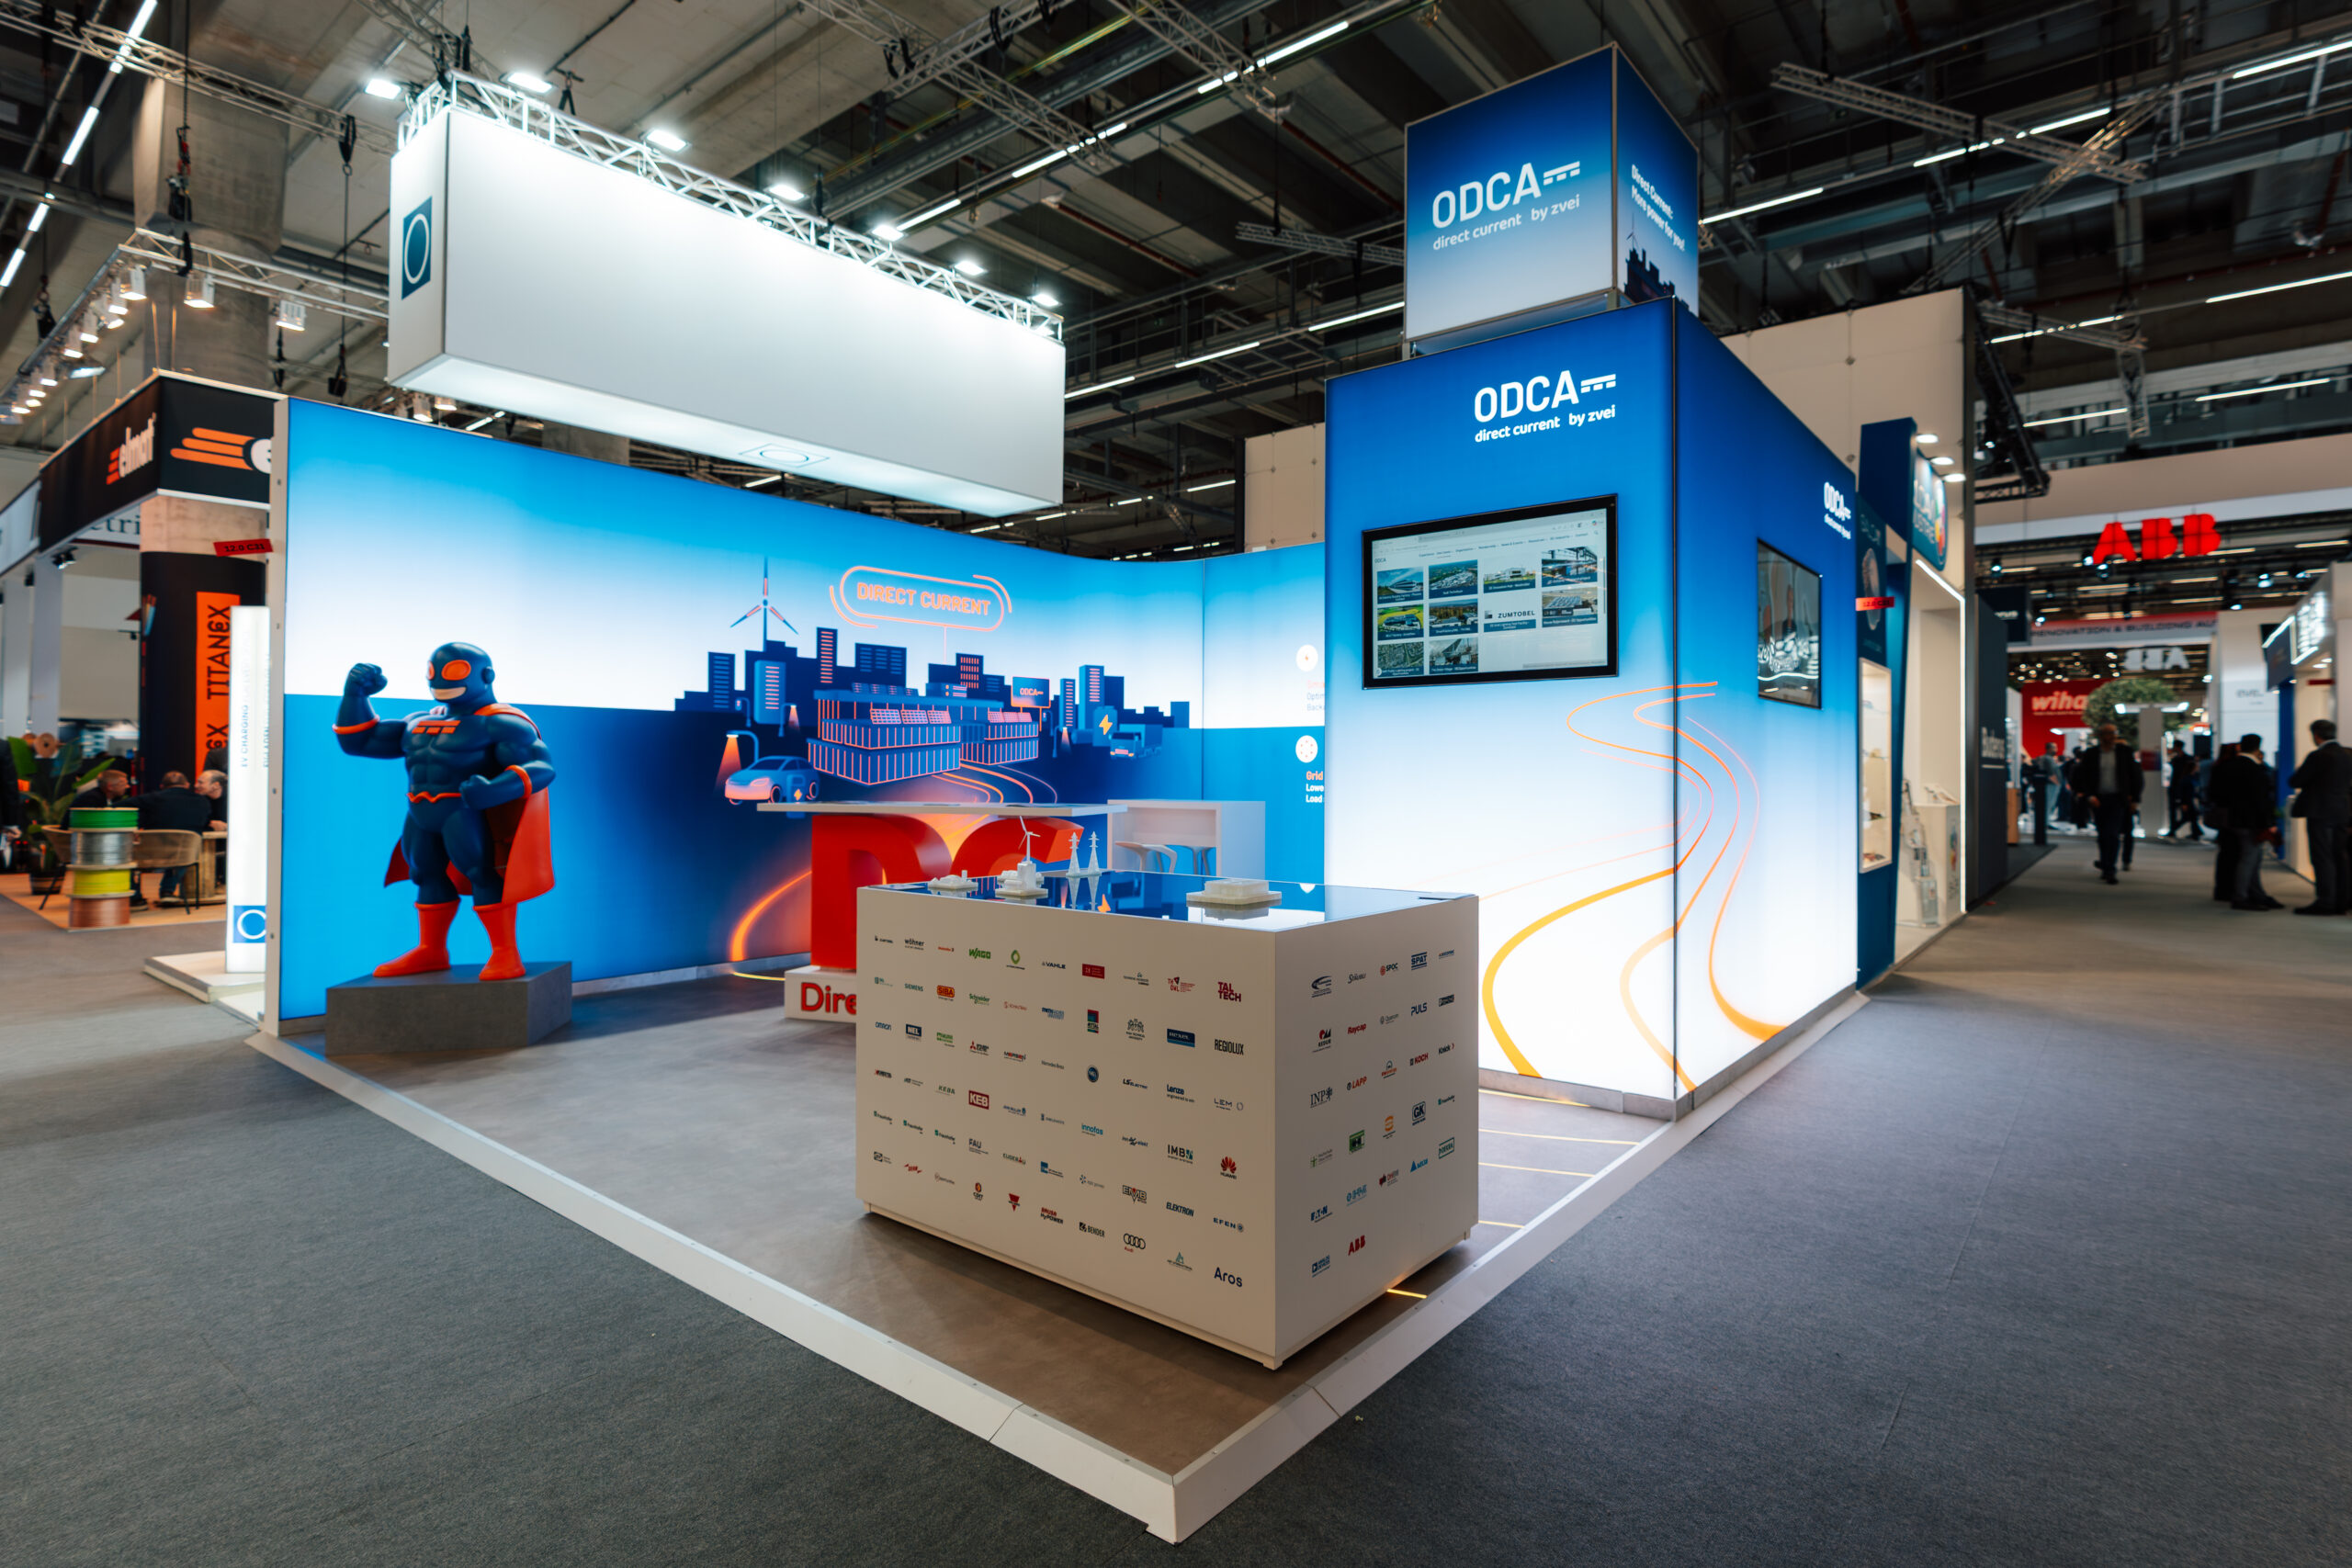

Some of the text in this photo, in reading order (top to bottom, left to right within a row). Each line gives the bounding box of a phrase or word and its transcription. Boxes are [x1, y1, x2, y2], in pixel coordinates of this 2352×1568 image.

[1631, 164, 1650, 196] Direct
[1432, 163, 1542, 229] ODCA
[1631, 184, 1647, 212] More
[1646, 204, 1665, 230] power
[1432, 194, 1580, 251] direct current by zvei
[1475, 369, 1579, 423] ODCA
[1475, 403, 1616, 444] direct current by zvei
[2093, 513, 2222, 565] ABB
[857, 581, 991, 616] DIRECT CURRENT
[1498, 610, 1535, 619] ZUMTOBEL
[1306, 770, 1324, 781] Grid
[1306, 783, 1324, 792] Lowe
[1306, 794, 1323, 803] Load
[904, 938, 924, 947] wöhner
[968, 947, 991, 960] WAGO
[1411, 954, 1427, 964] SPAT
[1046, 962, 1067, 970] VAHLE
[1385, 962, 1398, 972] SPOC
[904, 983, 924, 992] SIEMENS
[1217, 981, 1235, 993] TAL
[801, 981, 856, 1015] Dire
[1217, 990, 1242, 1003] TECH
[1410, 1002, 1428, 1017] PULS
[1347, 1023, 1367, 1035] Raycap
[1214, 1038, 1245, 1055] REGIOLUX
[1414, 1053, 1429, 1065] KOCH
[1351, 1076, 1367, 1089] LAPP
[938, 1085, 956, 1095] KEBA
[1166, 1084, 1185, 1095] Lenze
[969, 1092, 989, 1108] KEB
[1214, 1098, 1233, 1107] LEM
[1309, 1089, 1326, 1106] INP
[1413, 1103, 1425, 1119] GK
[968, 1137, 982, 1148] FAU
[1220, 1171, 1238, 1179] HUAWEI
[1165, 1201, 1194, 1217] ELEKTRON
[1213, 1217, 1237, 1229] EFEN
[1087, 1224, 1105, 1238] BENDER
[1348, 1234, 1366, 1257] ABB
[1214, 1266, 1243, 1287] Aros
